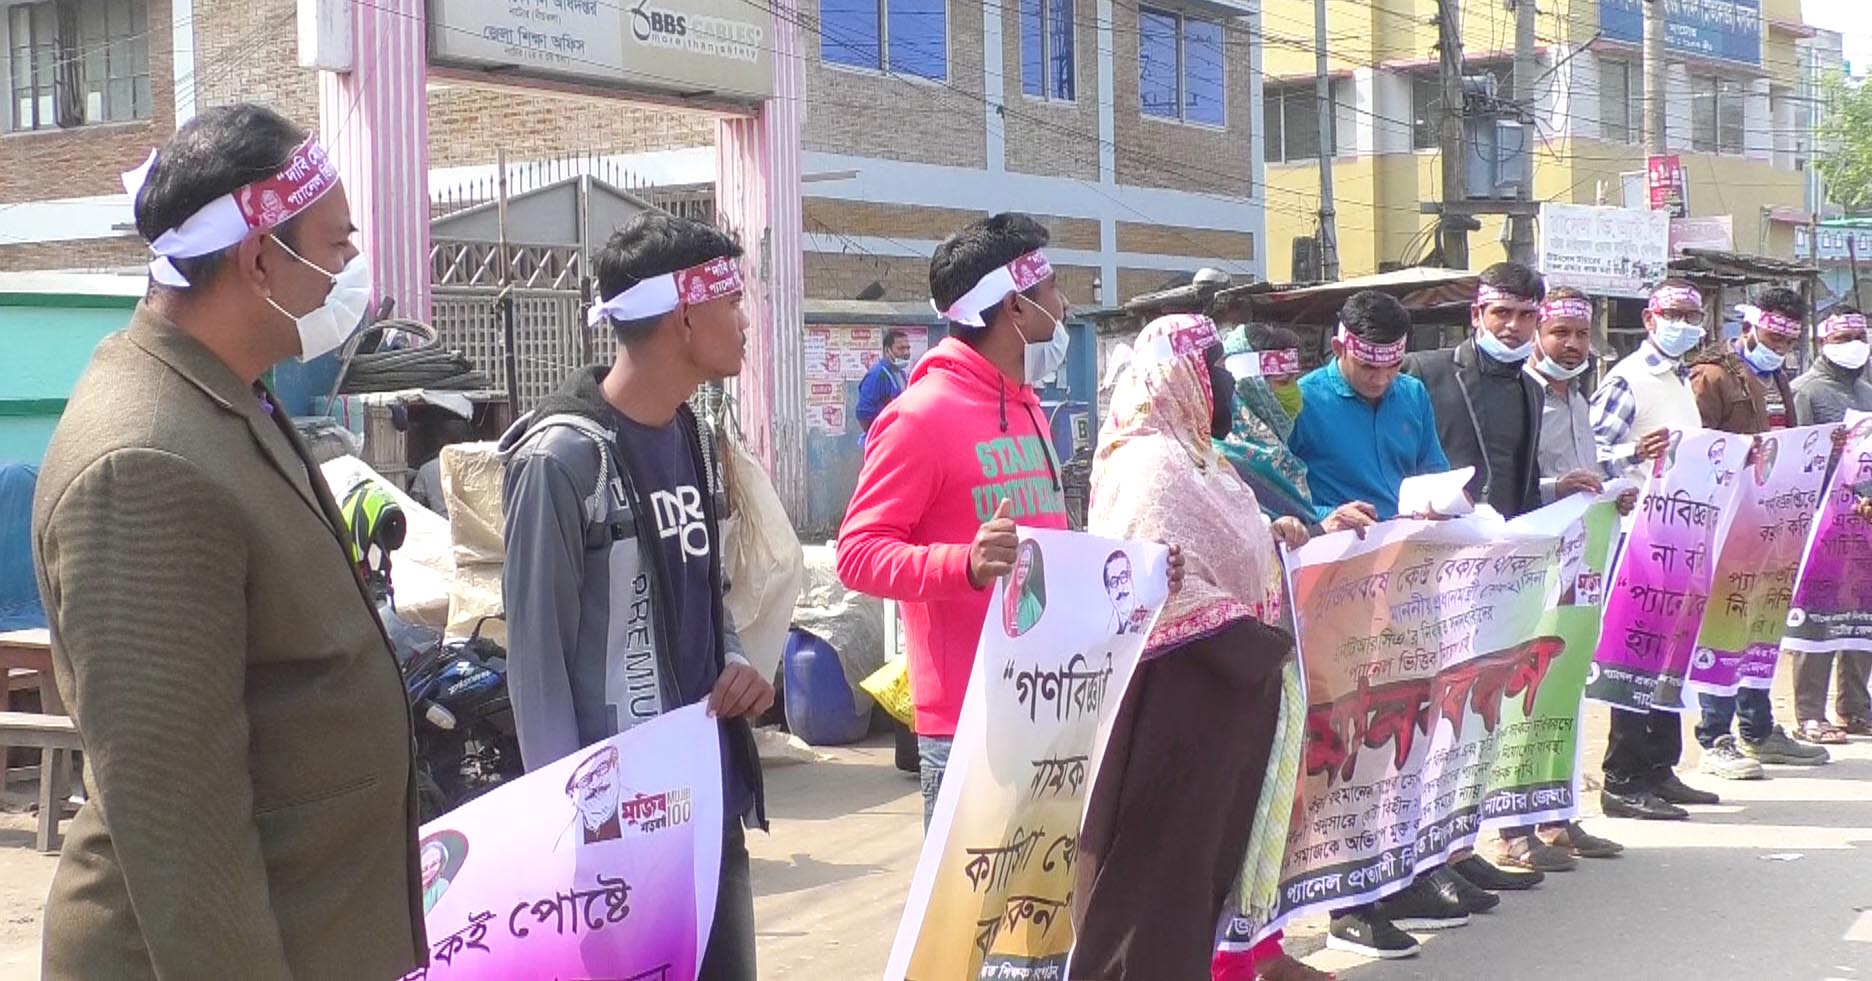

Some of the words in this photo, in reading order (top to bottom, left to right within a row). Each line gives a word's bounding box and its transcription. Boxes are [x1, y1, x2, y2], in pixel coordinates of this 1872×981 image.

[651, 12, 686, 36] BBS
[483, 25, 513, 44] জেলা
[517, 26, 547, 49] শিক্ষা
[551, 33, 585, 54] অফিস
[652, 34, 681, 45] more
[688, 40, 714, 52] than
[1436, 558, 1493, 583] বেকার
[1650, 544, 1677, 573] না
[623, 573, 660, 727] PREMIU
[621, 791, 666, 826] মুজিব
[667, 800, 691, 828] 100
[1287, 873, 1343, 904] প্যানেল
[1348, 853, 1397, 889] প্রত্যাশী
[1485, 790, 1528, 815] নাটোর
[1294, 839, 1340, 866] সমাজকে
[509, 874, 632, 938] পোষ্টে
